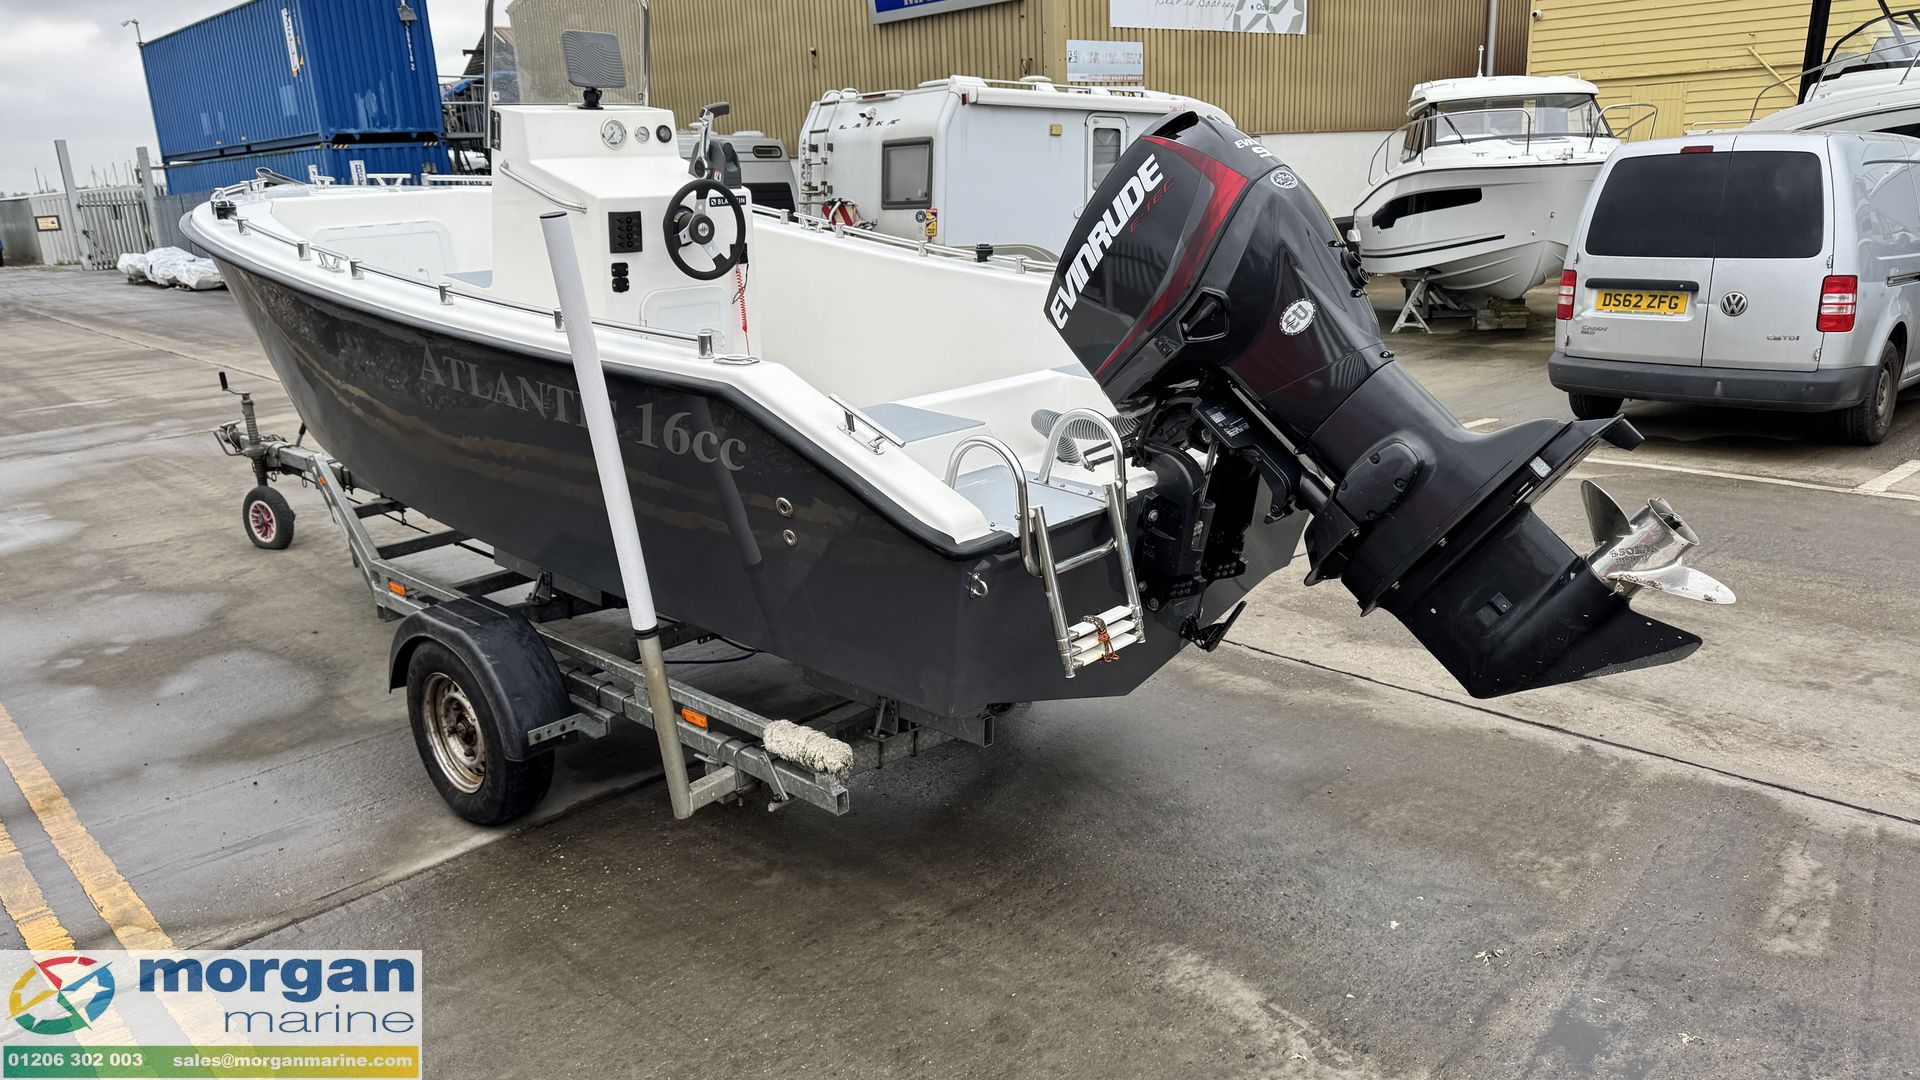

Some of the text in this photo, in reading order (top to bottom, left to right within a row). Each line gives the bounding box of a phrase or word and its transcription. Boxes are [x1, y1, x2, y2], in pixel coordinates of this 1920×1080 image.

[838, 119, 901, 130] LAIKA
[1130, 175, 1176, 233] E-TEC
[1050, 153, 1164, 330] EVINRUDE
[1602, 293, 1680, 310] DS62 ZFG
